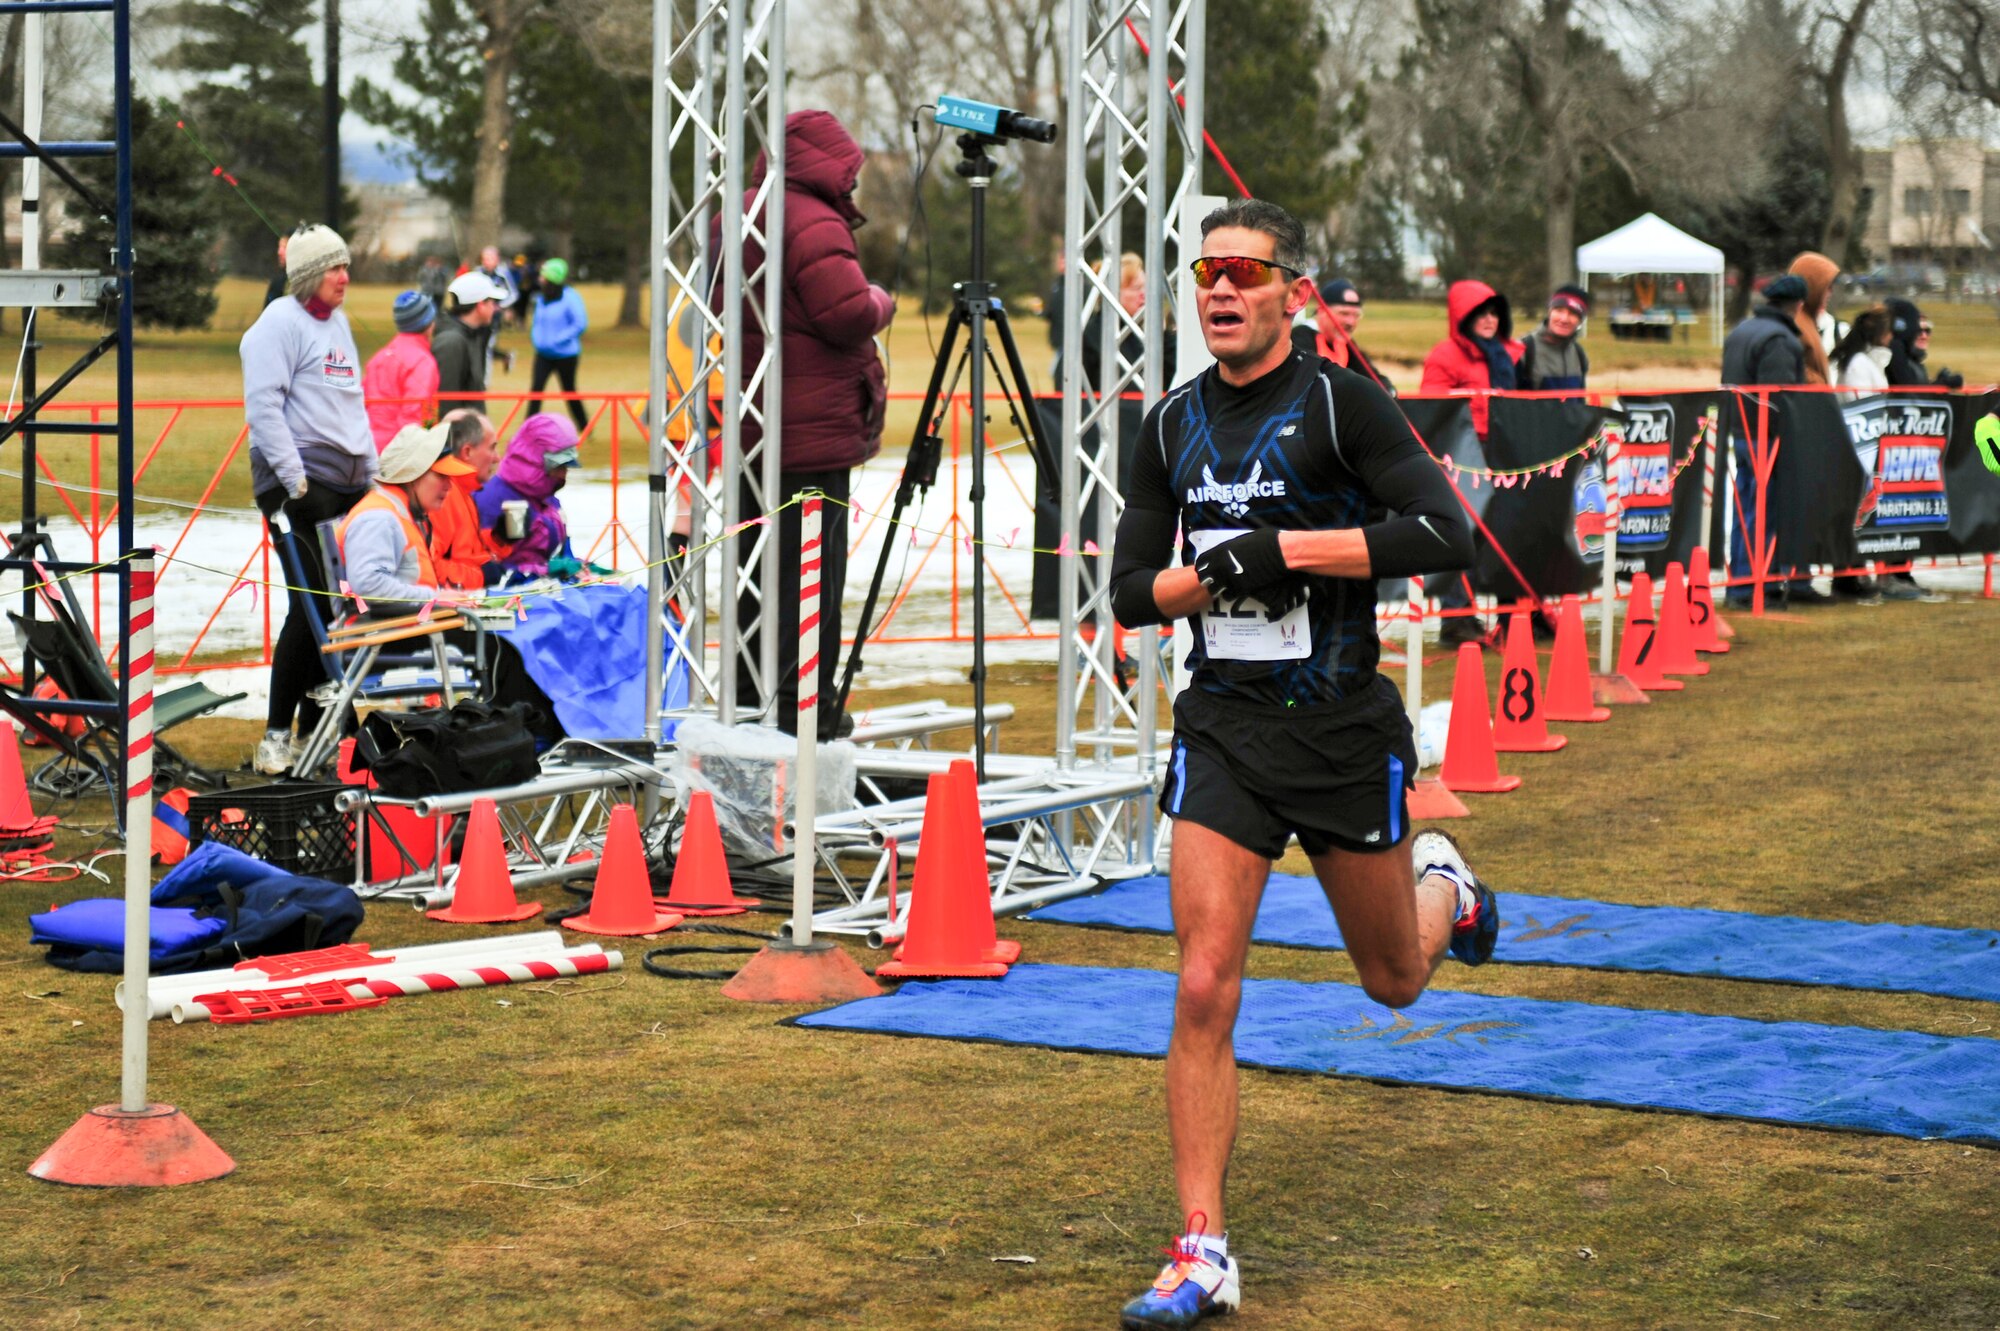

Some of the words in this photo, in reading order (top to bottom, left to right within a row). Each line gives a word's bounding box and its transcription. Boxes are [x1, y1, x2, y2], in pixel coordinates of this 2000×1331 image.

[952, 106, 985, 121] LYNX
[1903, 406, 1946, 435] Roll
[1187, 487, 1217, 503] AIR
[1222, 481, 1286, 500] FORCE
[1687, 585, 1709, 625] 5
[1632, 619, 1655, 665] 7
[1502, 667, 1535, 723] 8
